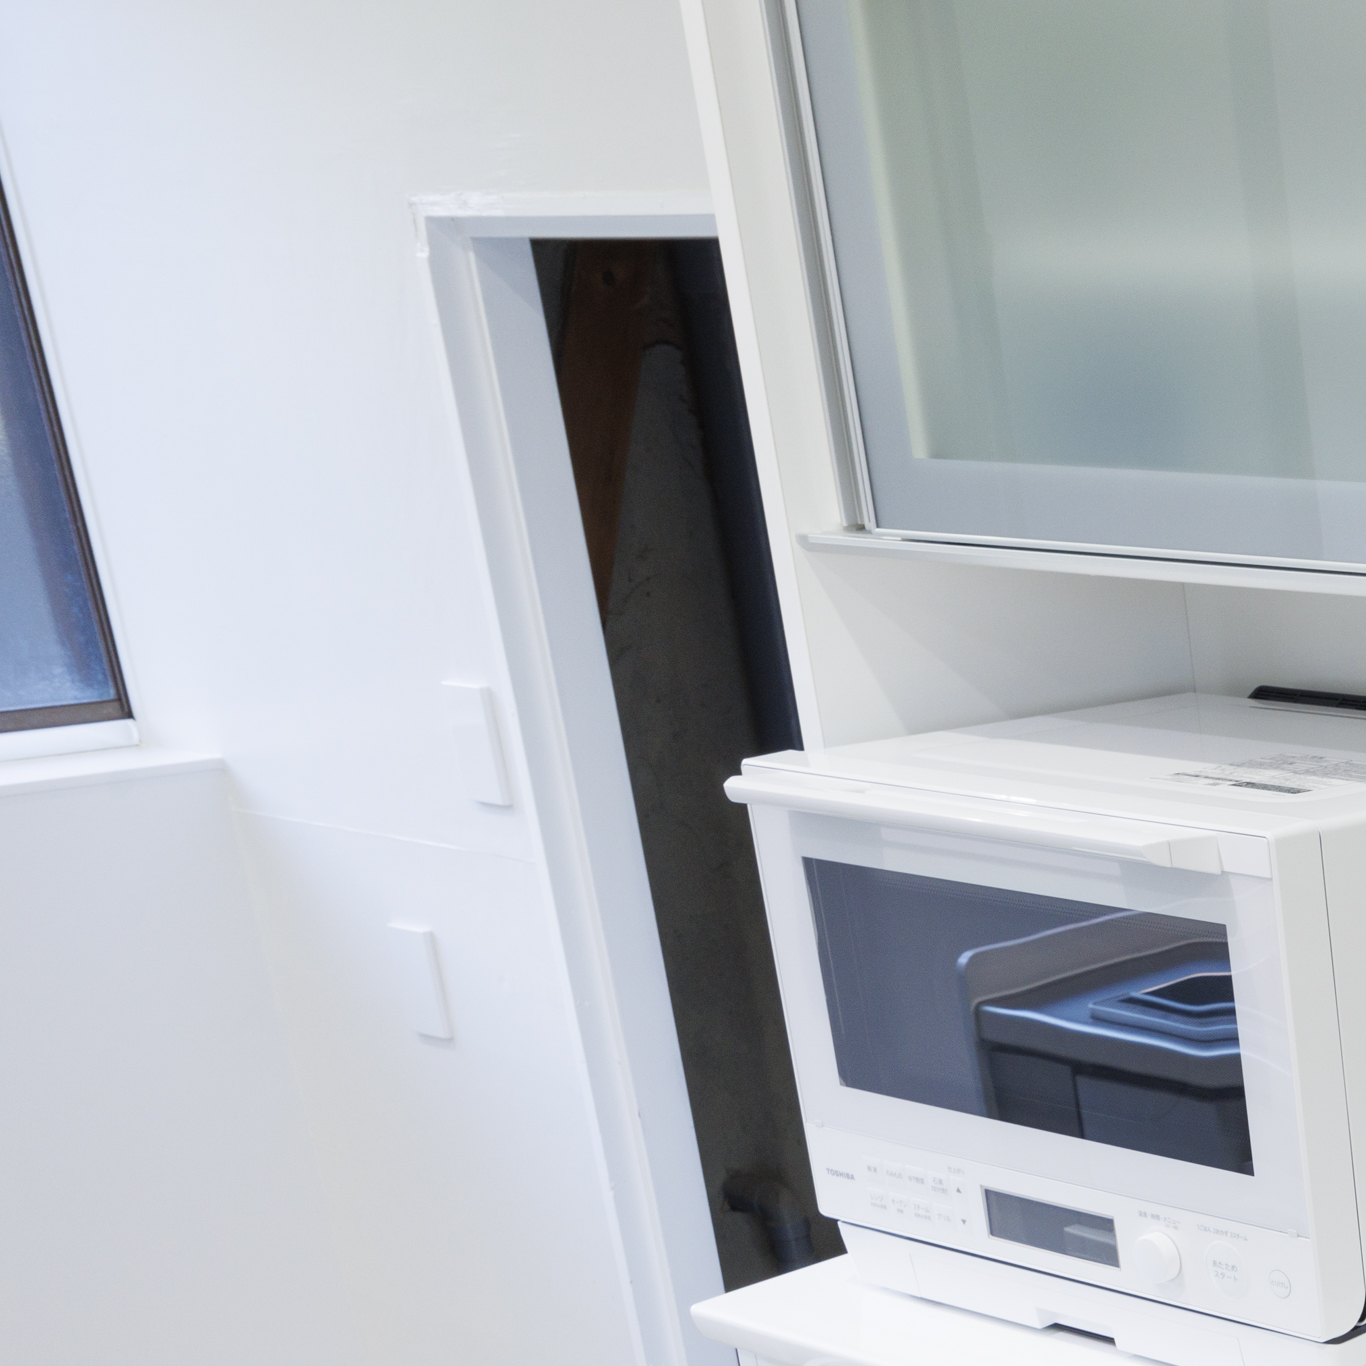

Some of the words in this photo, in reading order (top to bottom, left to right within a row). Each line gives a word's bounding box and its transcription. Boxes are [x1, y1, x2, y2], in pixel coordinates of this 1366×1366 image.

[825, 1167, 856, 1181] TOSHIBA
[1212, 1259, 1238, 1273] あたため
[1214, 1270, 1239, 1282] スタート
